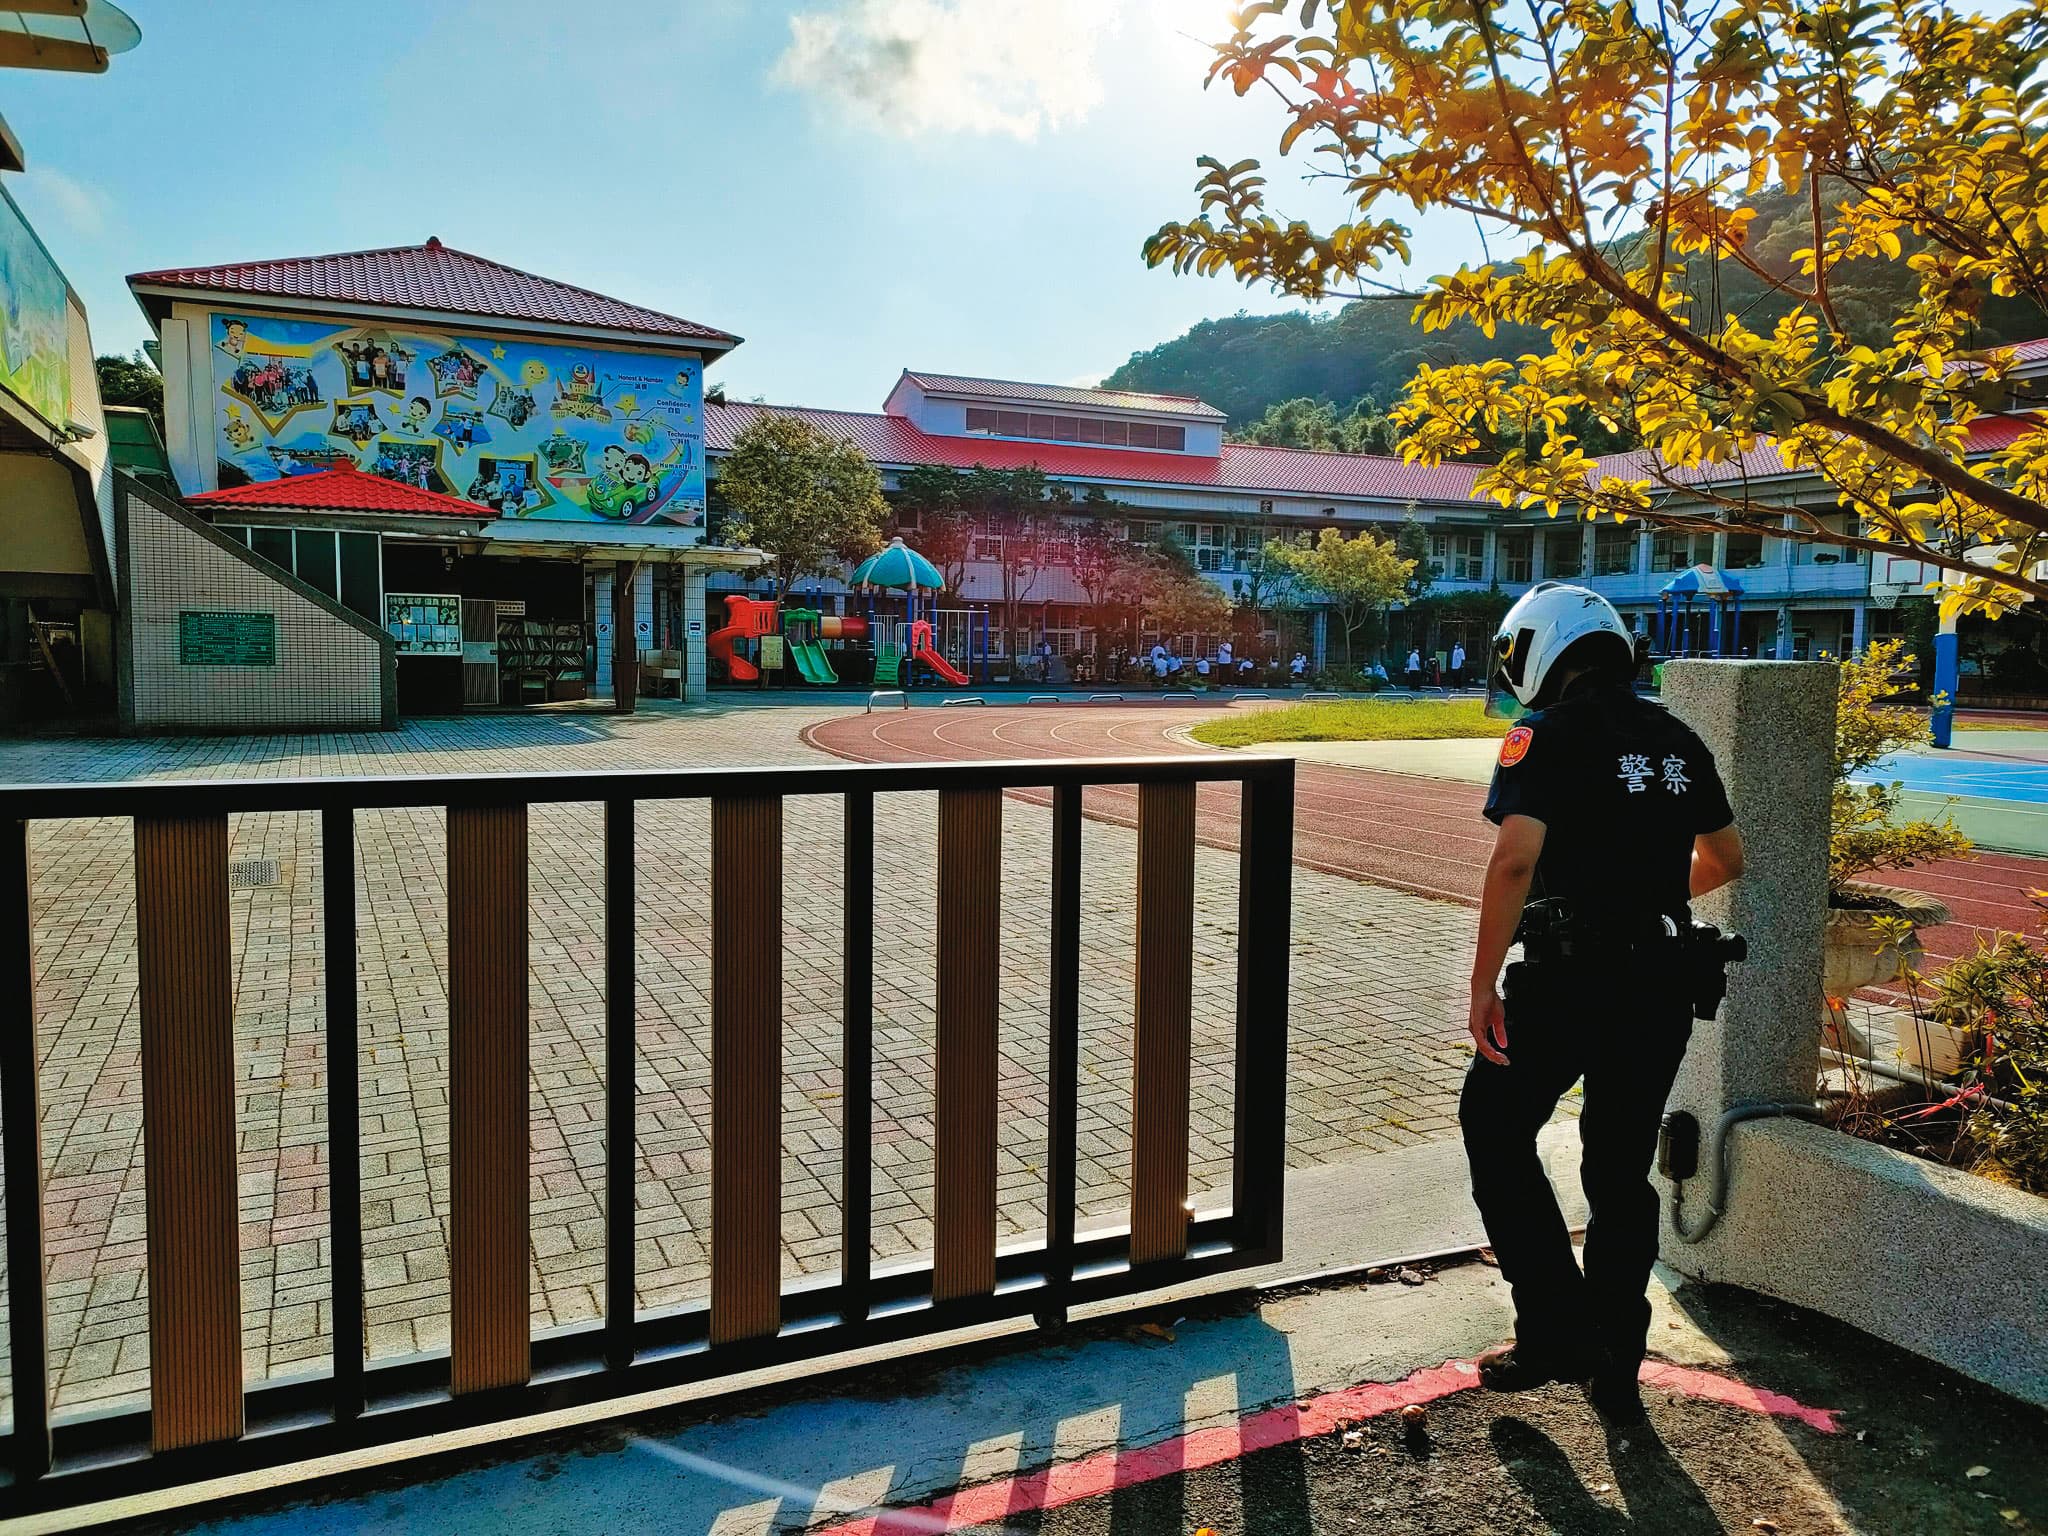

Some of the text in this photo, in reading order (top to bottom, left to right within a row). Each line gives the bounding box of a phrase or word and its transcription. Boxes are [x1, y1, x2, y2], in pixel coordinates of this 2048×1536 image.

[656, 400, 691, 408] Confidence
[667, 430, 700, 440] Technology
[660, 463, 698, 471] Humanities
[1616, 753, 1692, 795] 警察
